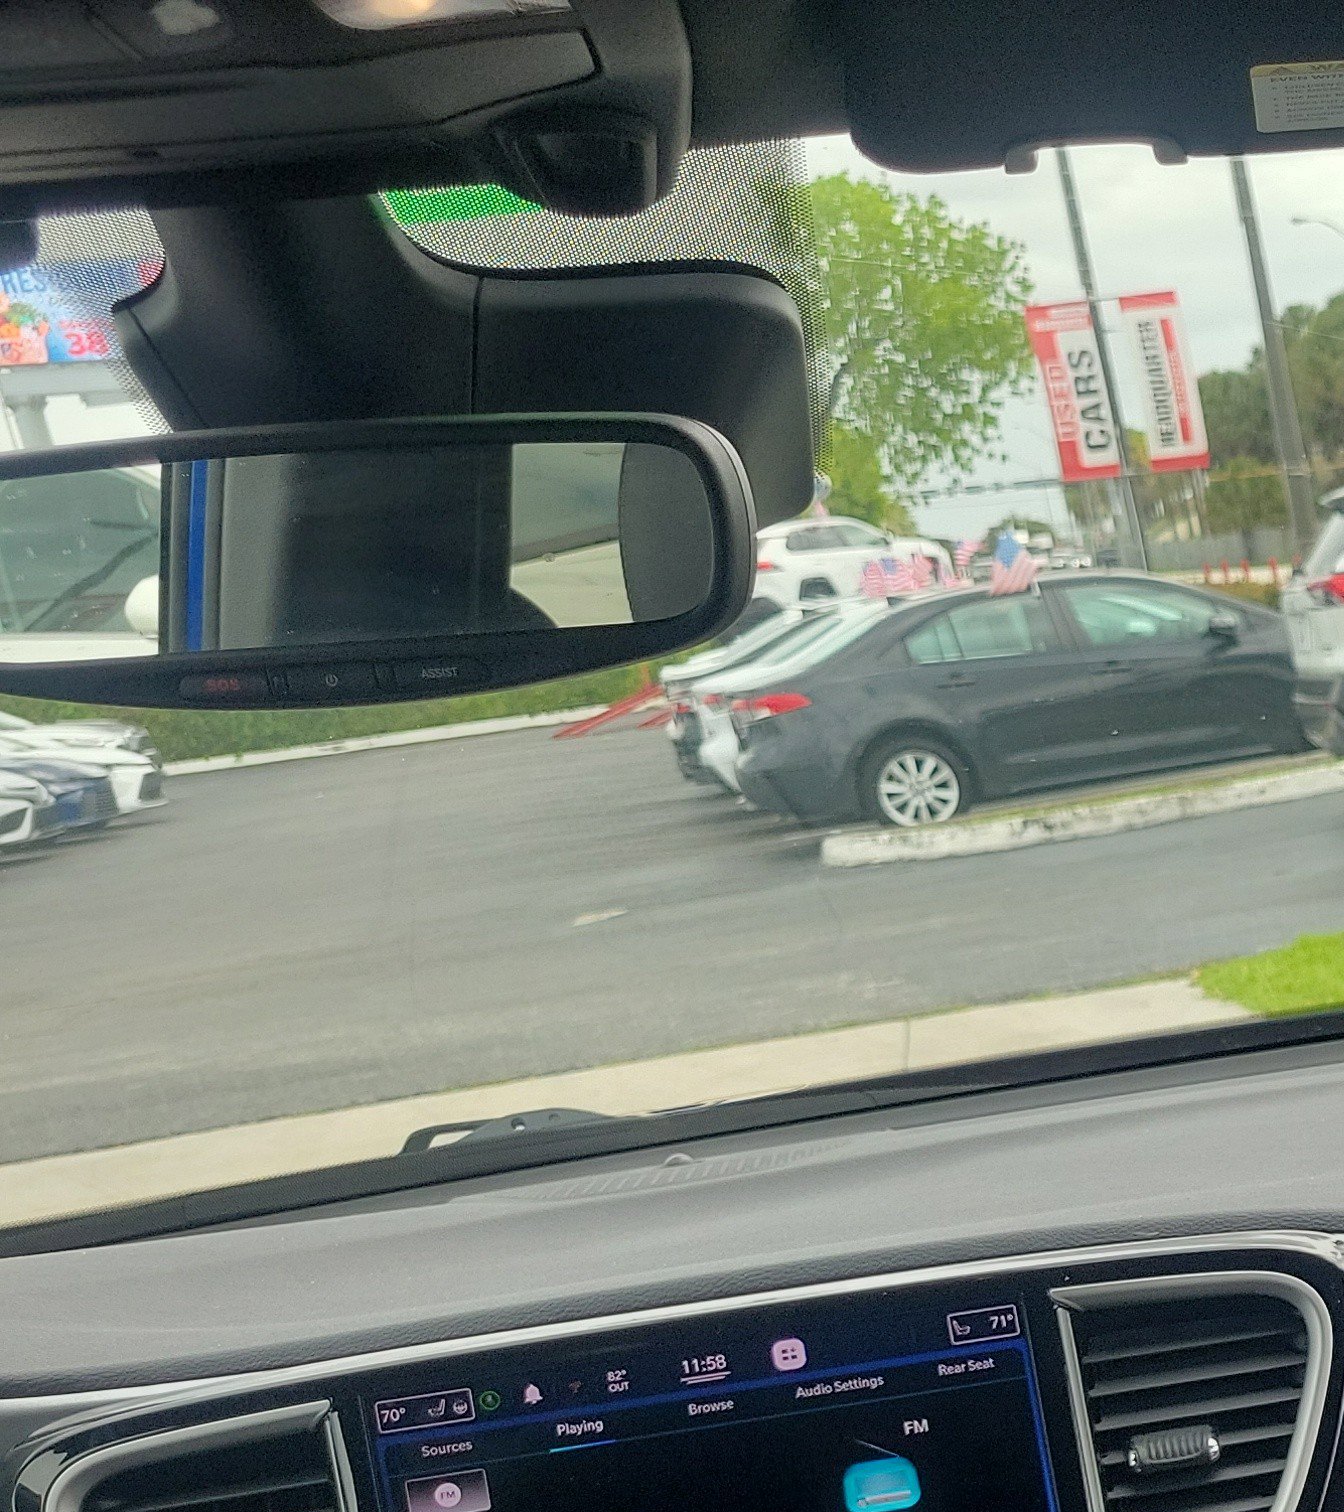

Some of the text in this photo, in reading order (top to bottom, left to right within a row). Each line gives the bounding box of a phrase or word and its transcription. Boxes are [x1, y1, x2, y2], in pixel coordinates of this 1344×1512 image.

[1049, 364, 1077, 439] USED
[1068, 350, 1111, 450] CARS
[420, 666, 459, 680] ASSIST
[205, 678, 239, 692] SOS
[680, 1353, 727, 1374] 11:58
[937, 1357, 996, 1377] Rear Seat
[608, 1380, 630, 1393] OUT
[795, 1375, 885, 1400] Audio Settings
[687, 1398, 735, 1416] Browse
[556, 1418, 604, 1437] Playing
[903, 1418, 929, 1436] FM
[421, 1440, 473, 1458] Sources
